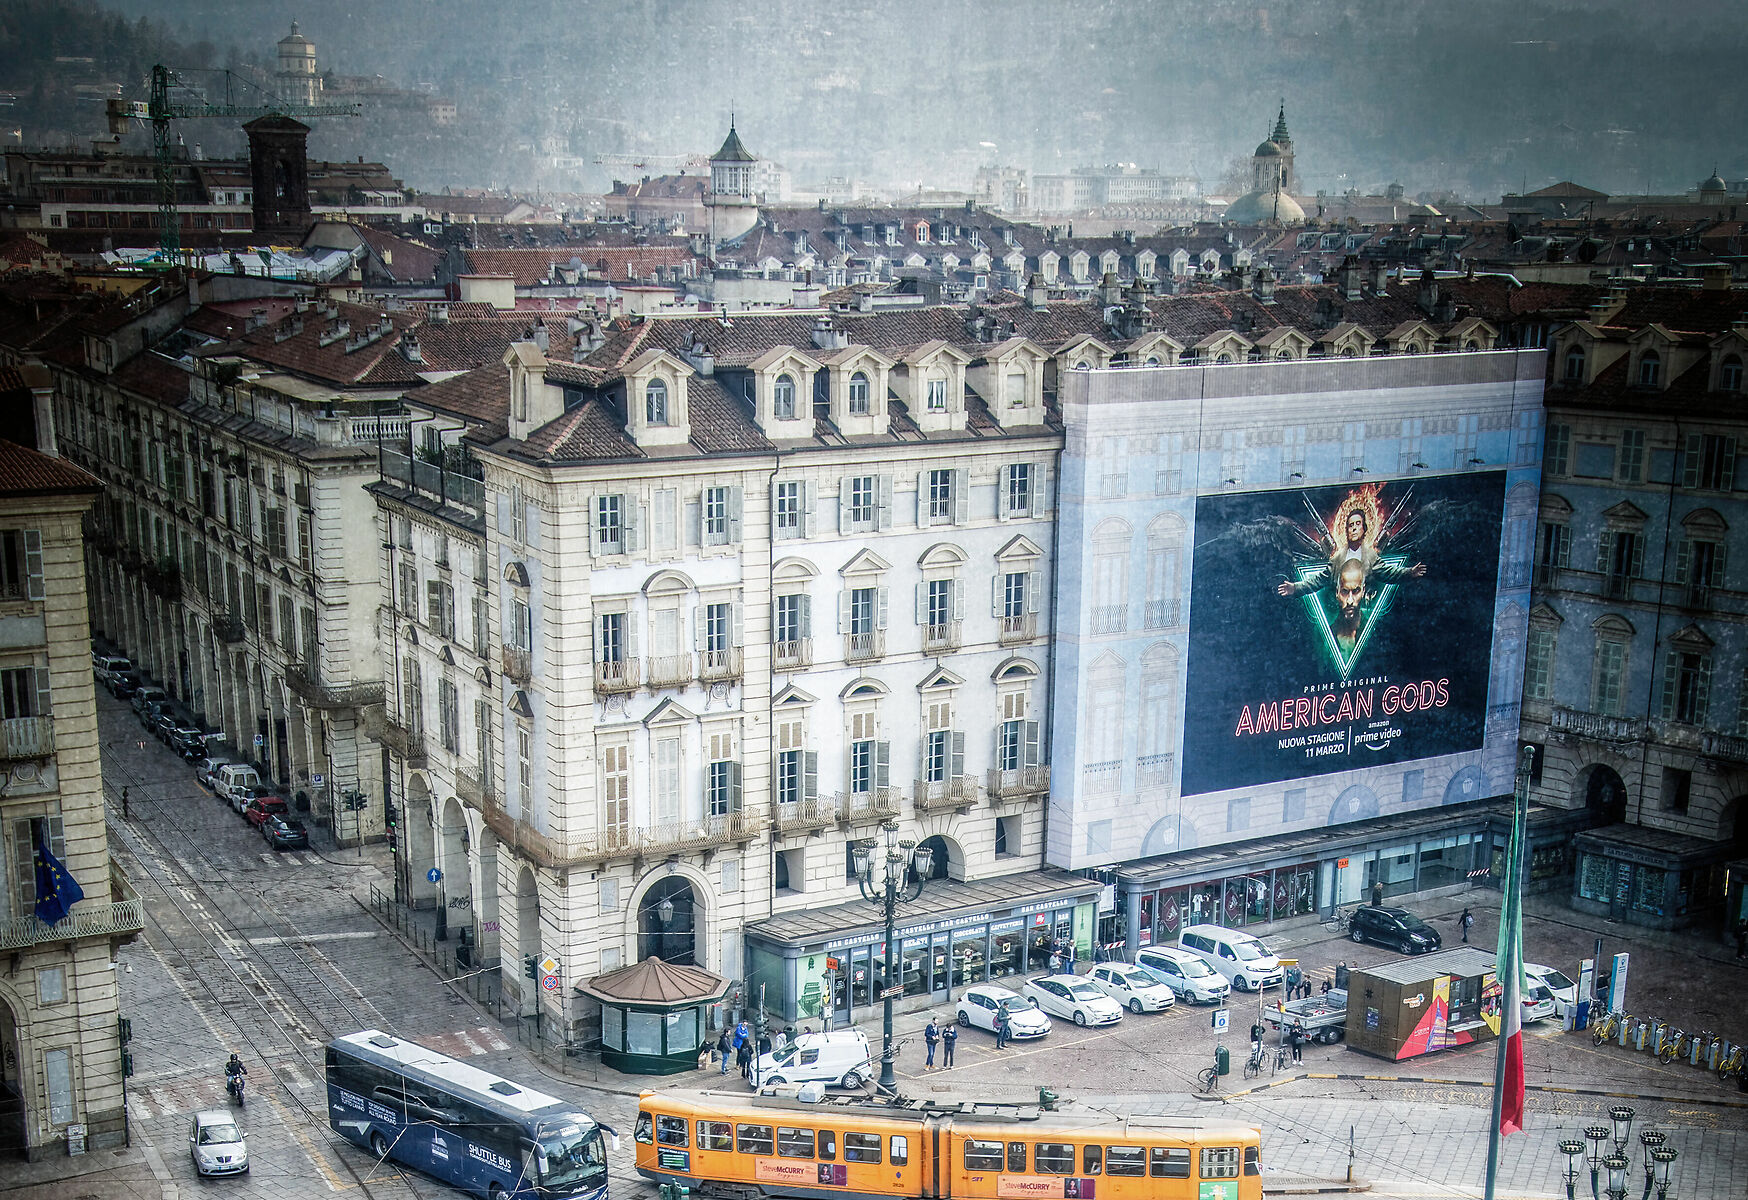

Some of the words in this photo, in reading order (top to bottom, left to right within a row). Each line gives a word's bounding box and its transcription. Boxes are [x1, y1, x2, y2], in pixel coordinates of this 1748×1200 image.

[1303, 682, 1335, 694] PRIME
[1340, 675, 1389, 689] ORIGINAL
[1235, 689, 1374, 737] AMERICAN
[1381, 678, 1450, 716] GODS
[1368, 720, 1390, 729] amazon
[1278, 737, 1306, 750] NUOVA
[1307, 731, 1346, 746] STAGIONE
[1354, 731, 1379, 746] prime
[1379, 728, 1402, 740] video
[1304, 748, 1315, 758] 11
[1315, 743, 1345, 757] MARZO
[1022, 905, 1034, 913] BAR
[1036, 899, 1068, 911] CASTELLO
[940, 920, 954, 928] BAR
[956, 914, 990, 925] CASTELLO
[1058, 913, 1069, 921] BAR
[900, 923, 936, 935] CASTELLO
[828, 940, 842, 949] BAR
[844, 934, 880, 946] CASTELLO
[469, 1143, 497, 1164] SHUTTLE
[498, 1156, 512, 1169] BUS
[1013, 1144, 1023, 1153] 13
